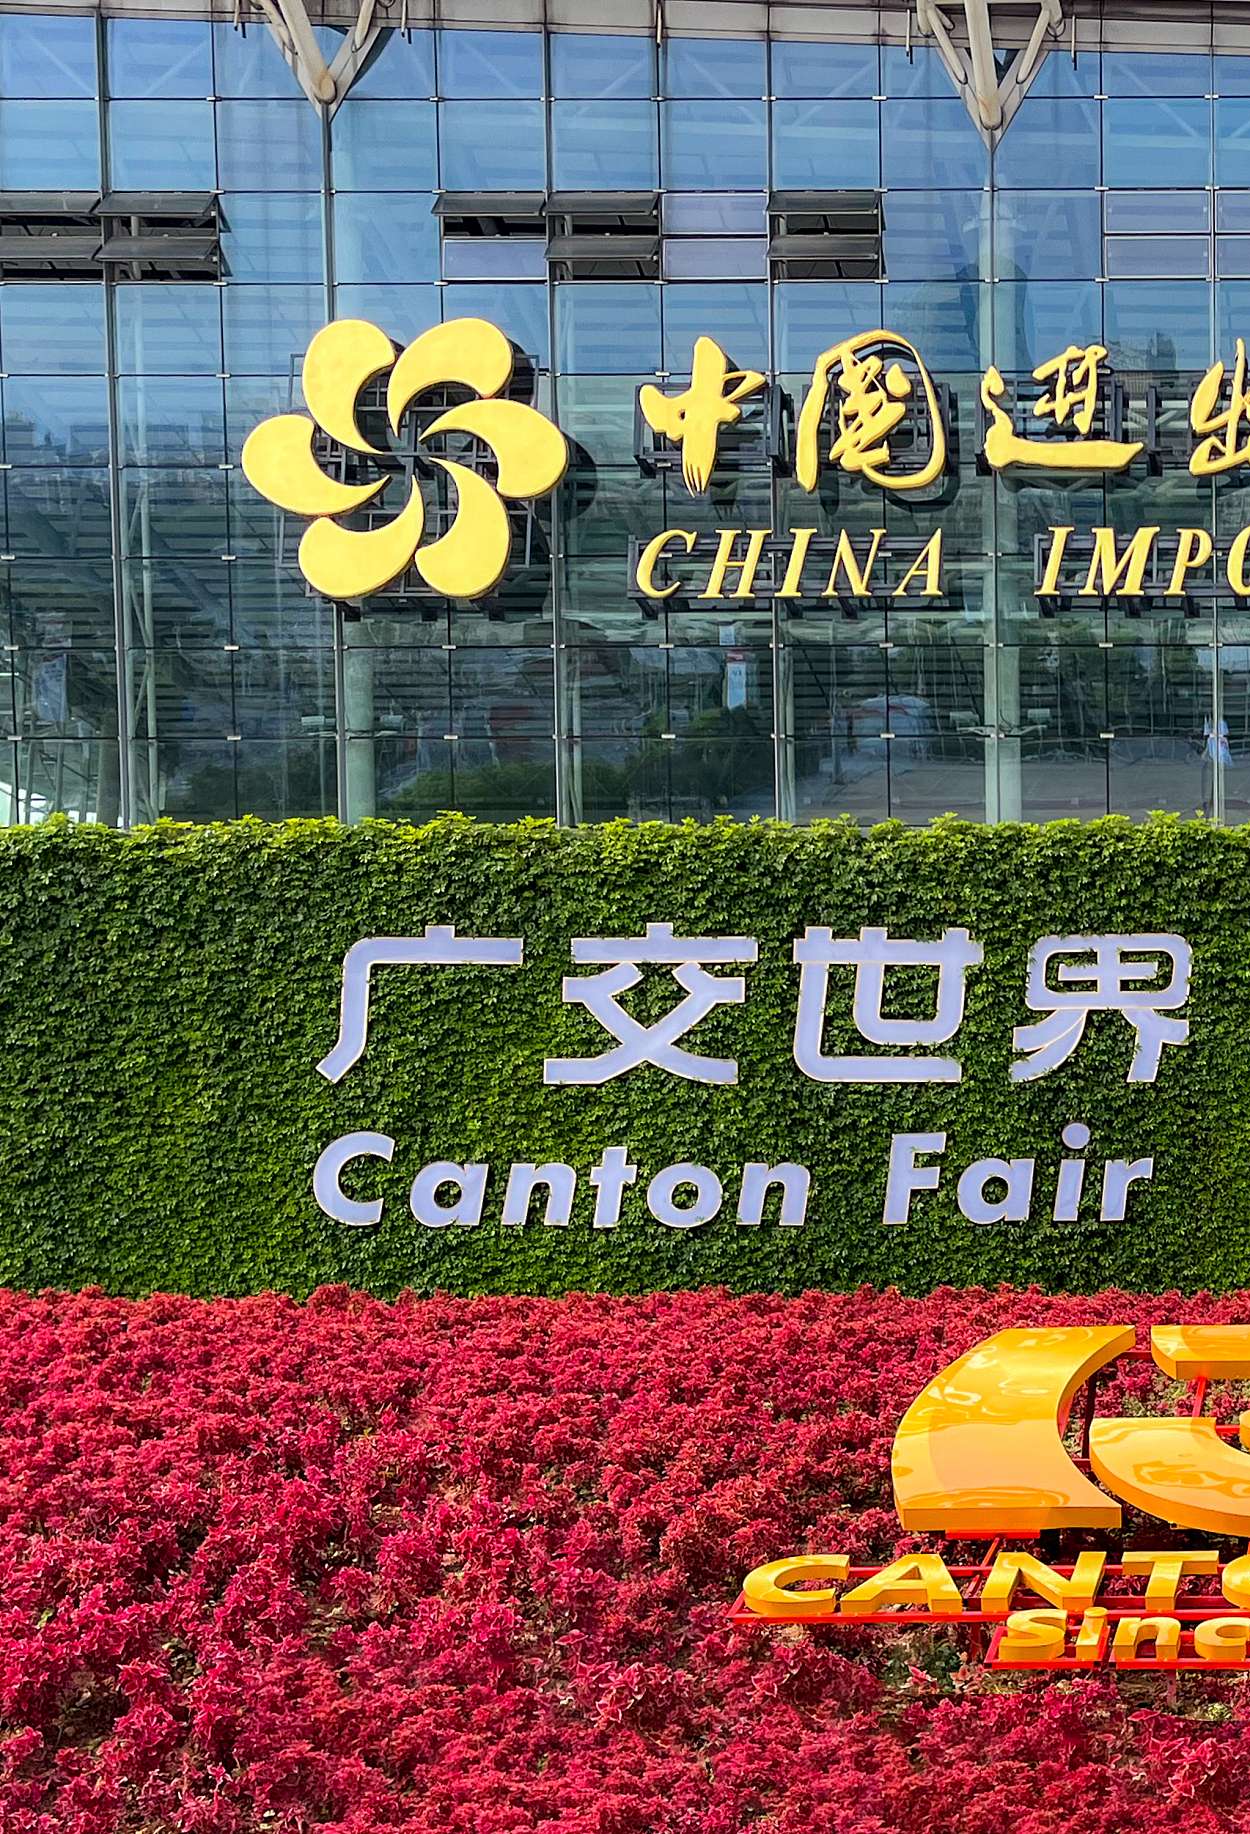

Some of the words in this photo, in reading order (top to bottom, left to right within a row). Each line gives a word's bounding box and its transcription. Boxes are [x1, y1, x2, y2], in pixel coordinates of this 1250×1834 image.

[634, 526, 946, 601] CHINA
[315, 921, 1193, 1086] 广交世界
[312, 1130, 813, 1230] Canton
[881, 1121, 1155, 1226] Fair
